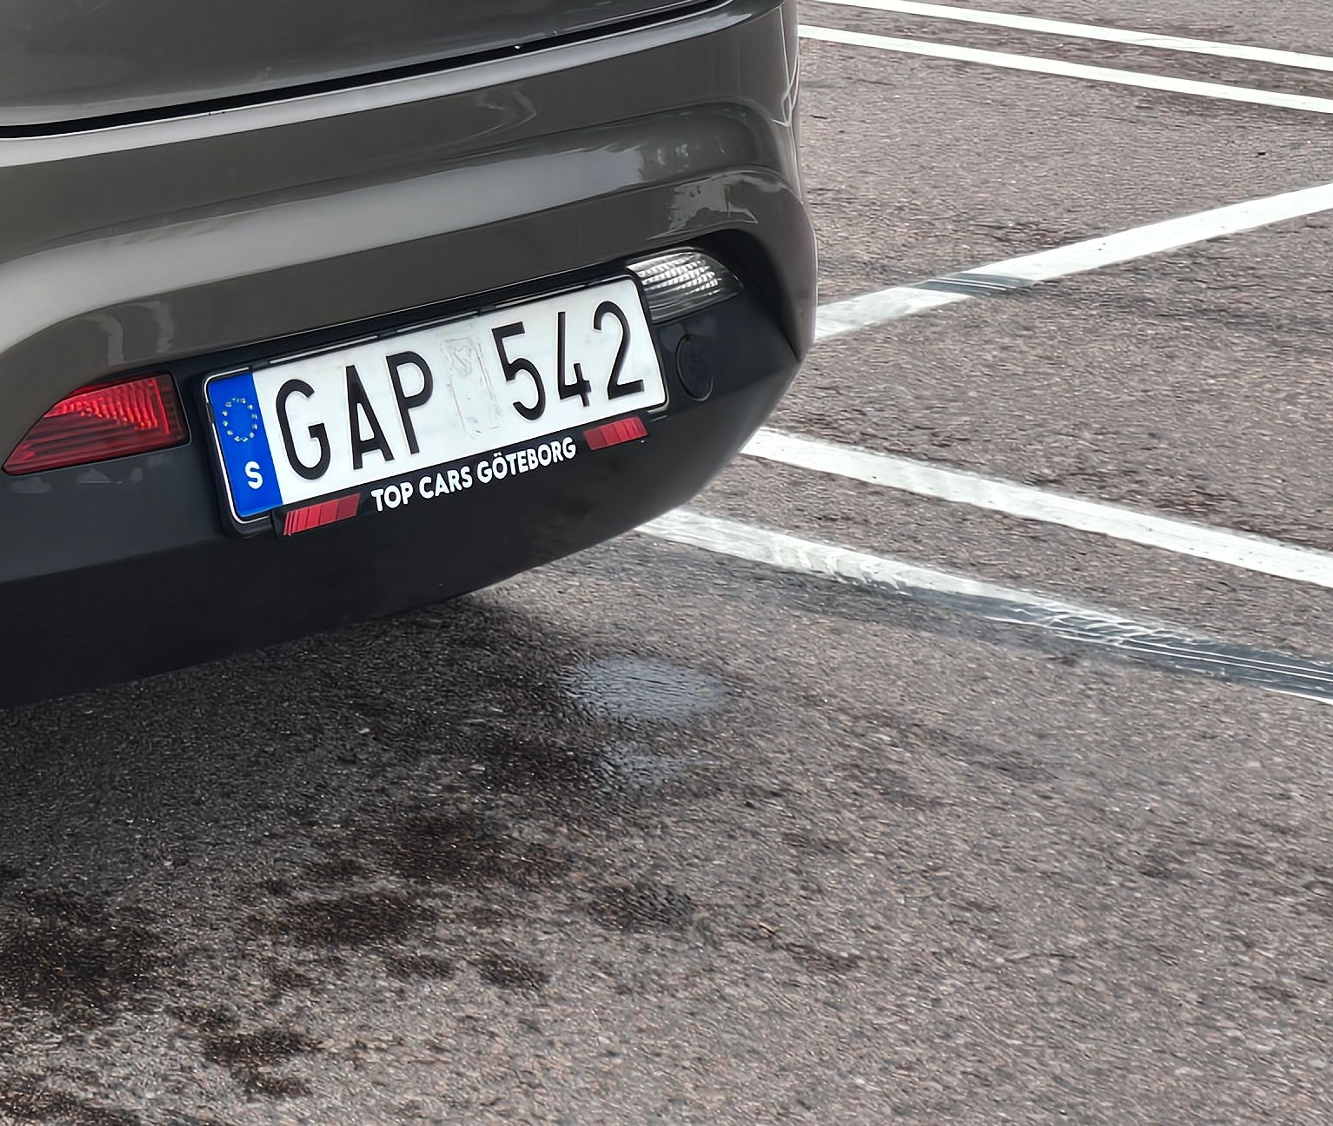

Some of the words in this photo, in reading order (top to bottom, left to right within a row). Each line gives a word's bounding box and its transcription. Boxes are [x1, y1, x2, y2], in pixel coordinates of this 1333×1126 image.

[275, 351, 434, 481] GAP
[491, 300, 645, 421] 542
[244, 460, 264, 490] S
[370, 481, 414, 512] TOP
[418, 466, 473, 499] CARS
[476, 437, 577, 484] GÖTEBORG
